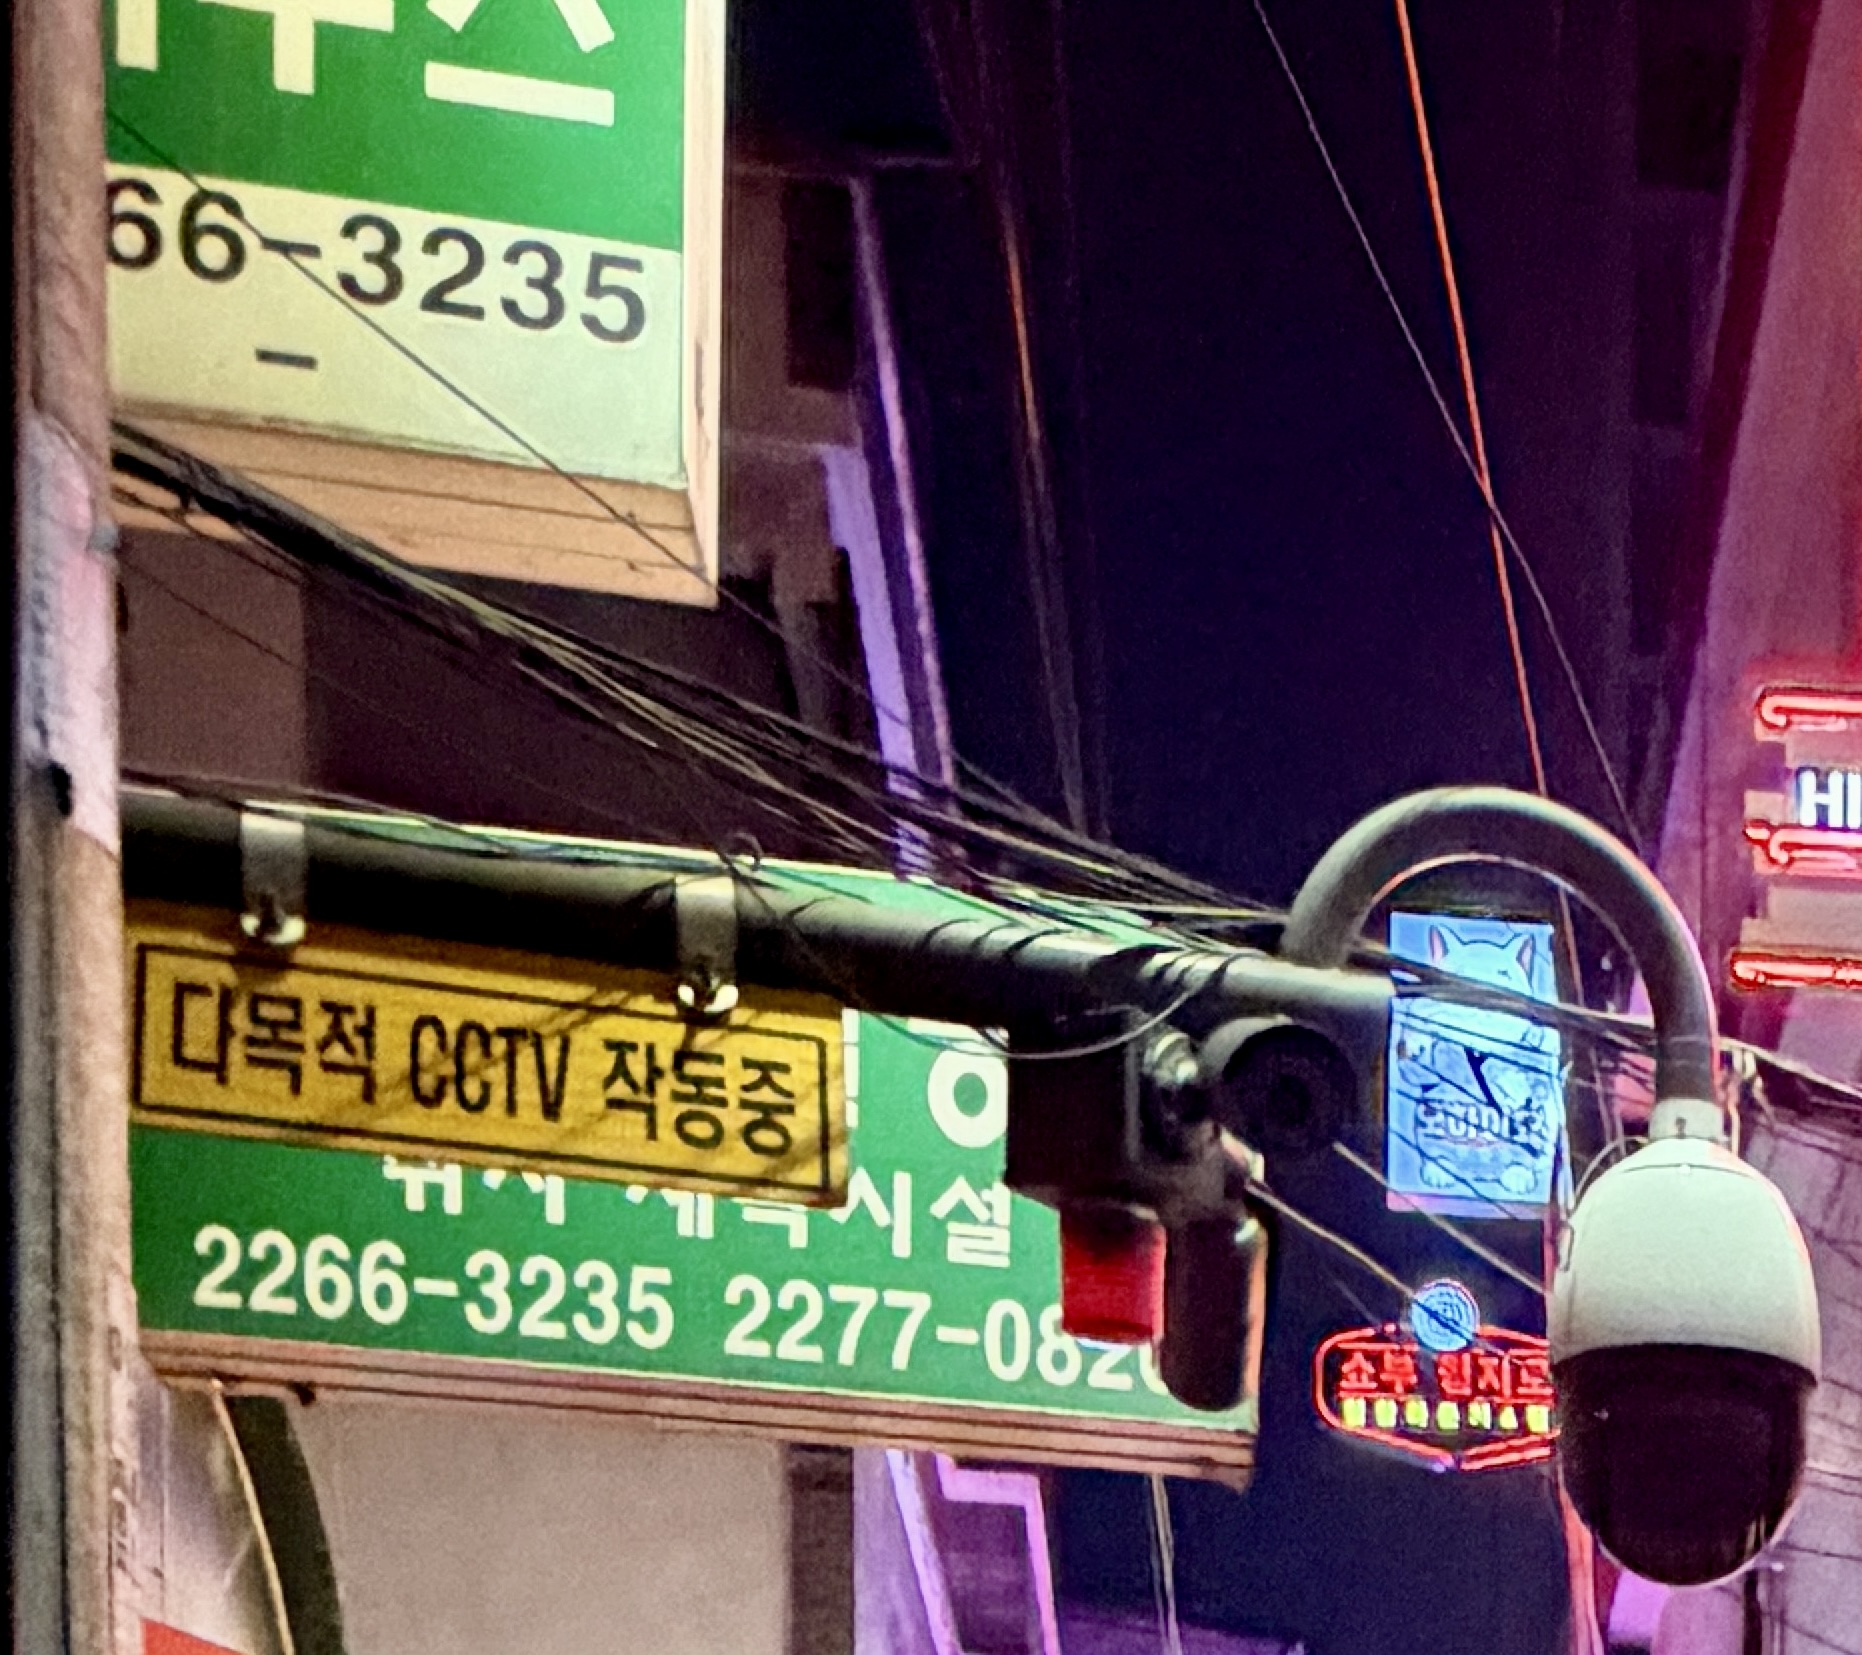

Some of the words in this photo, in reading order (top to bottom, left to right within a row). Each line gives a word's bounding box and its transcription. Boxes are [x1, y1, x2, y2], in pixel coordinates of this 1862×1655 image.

[172, 978, 378, 1104] 다목적
[409, 1014, 572, 1122] CCTV
[600, 1038, 796, 1157] 작동중
[193, 1223, 675, 1349] 2266-3235
[724, 1274, 1170, 1396] 2277-082
